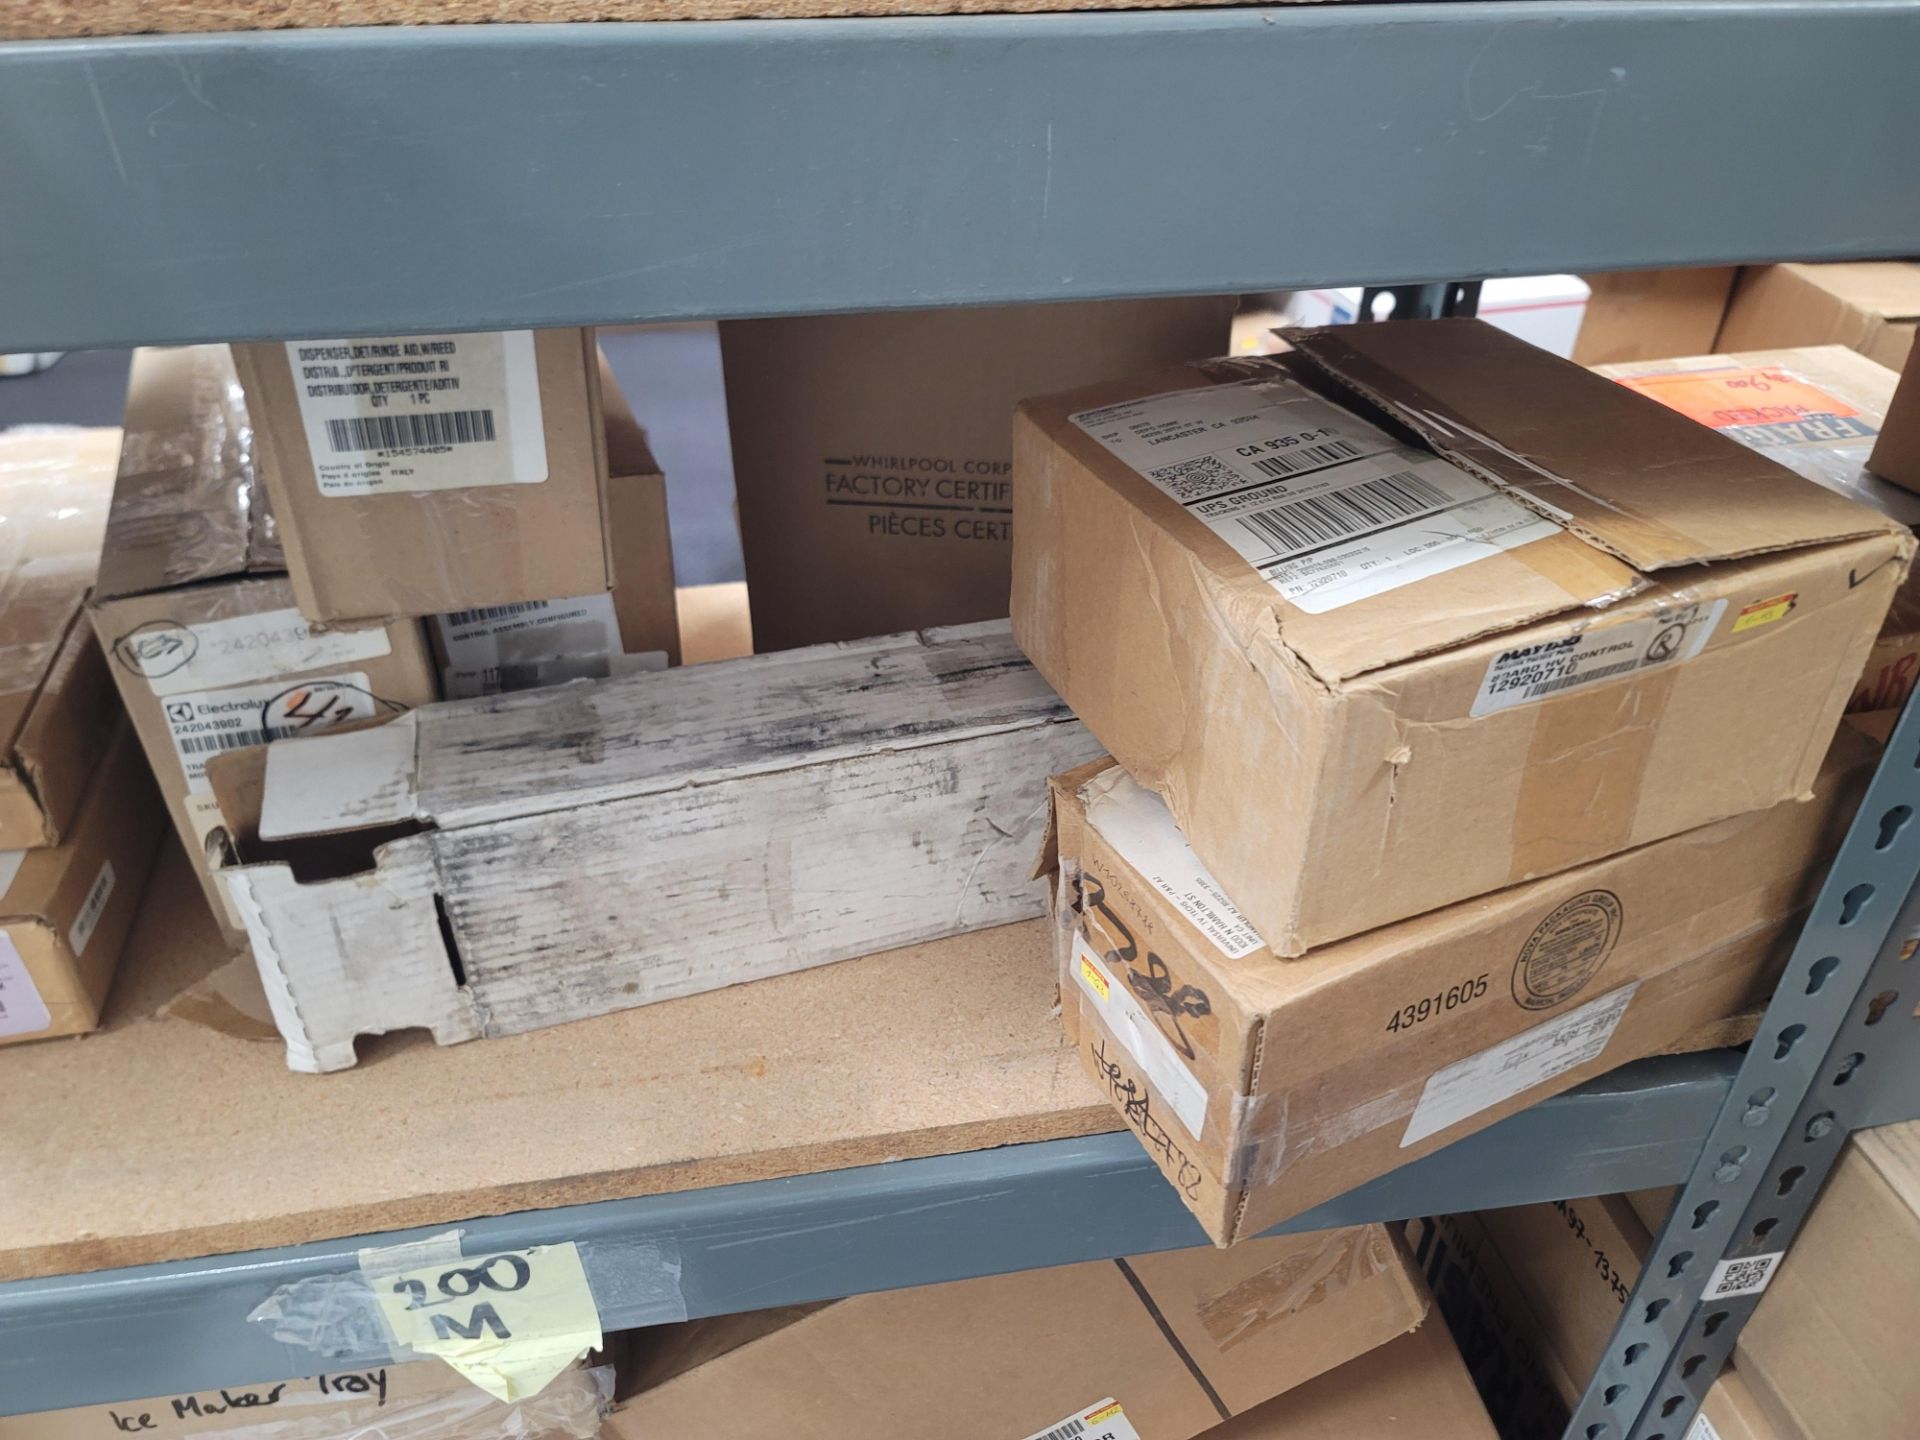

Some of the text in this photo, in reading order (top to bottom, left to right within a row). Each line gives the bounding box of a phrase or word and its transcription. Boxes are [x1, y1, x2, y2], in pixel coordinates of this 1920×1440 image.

[1147, 426, 1206, 446] LANCASTER
[1235, 444, 1264, 458] CA
[1266, 434, 1300, 452] 935
[852, 455, 956, 474] WHIRLPOOL
[825, 473, 930, 498] FACTORY
[1197, 494, 1229, 516] UPS
[1227, 485, 1288, 507] GROUND
[868, 511, 946, 538] PIÈCES
[1568, 640, 1635, 663] CONTROL
[1488, 662, 1578, 695] 12920710
[174, 716, 243, 735] 242043902
[1189, 899, 1229, 930] HAMILTON
[1385, 973, 1490, 1034] 4391605
[430, 1300, 512, 1340] M
[304, 1368, 388, 1406] Tray
[110, 1382, 286, 1433] Ice Maker
